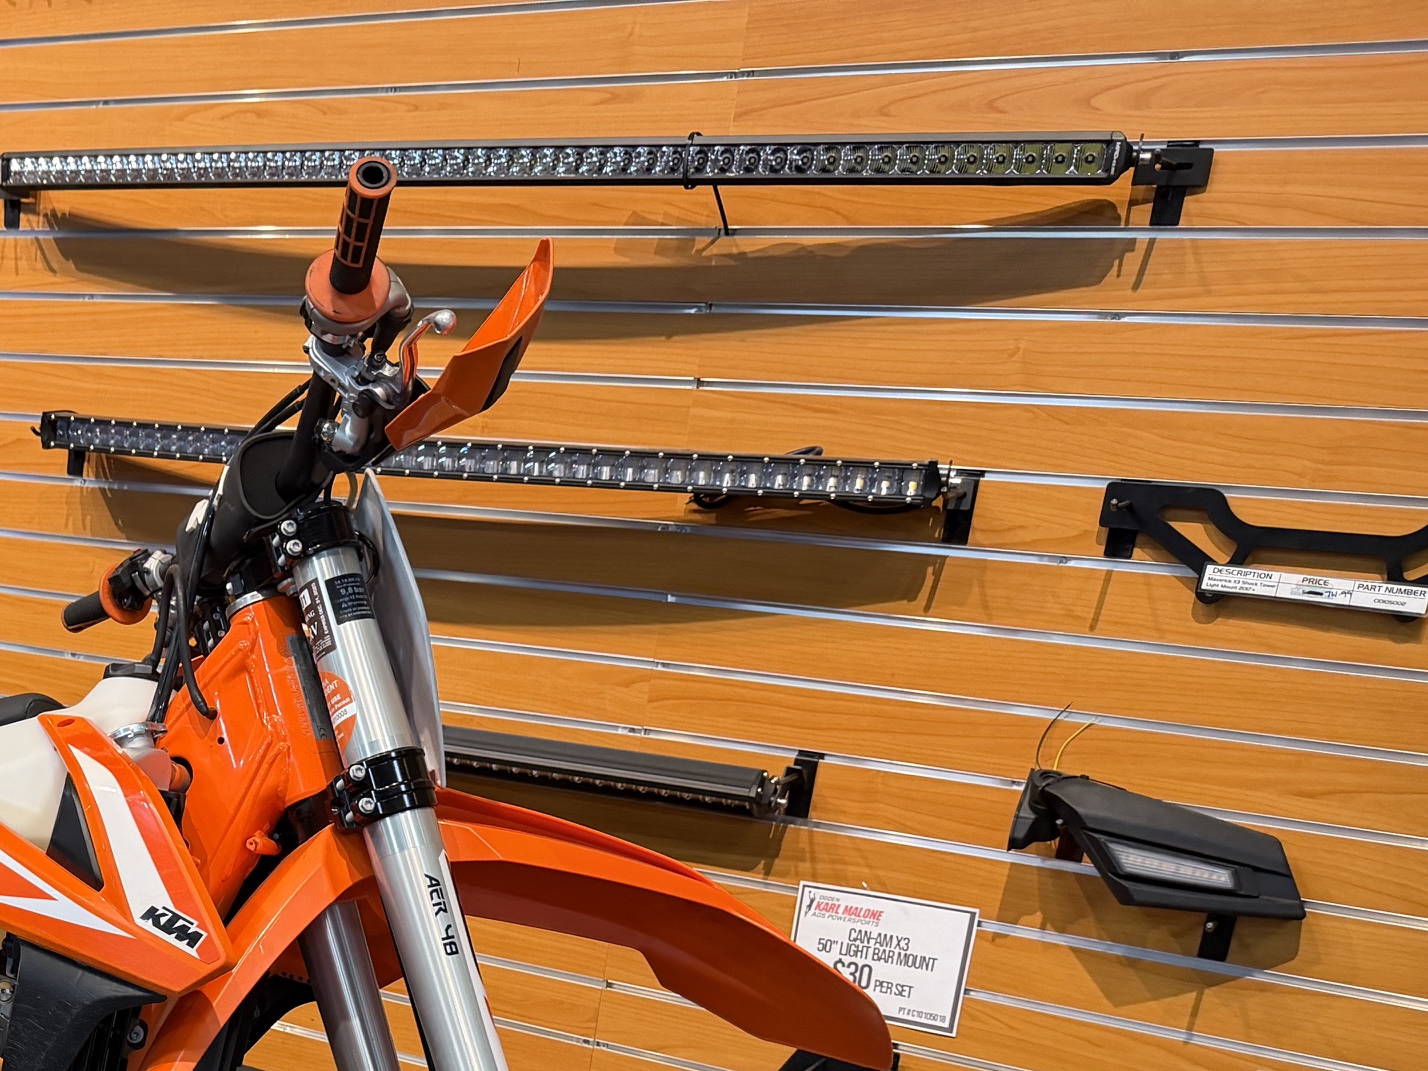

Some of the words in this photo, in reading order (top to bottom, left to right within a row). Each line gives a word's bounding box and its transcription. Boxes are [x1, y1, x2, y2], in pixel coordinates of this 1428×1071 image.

[1207, 576, 1232, 584] Maverick
[1242, 579, 1258, 587] Shock
[1212, 567, 1273, 580] DESCRIPTION
[1301, 576, 1330, 586] PRICE
[1220, 583, 1238, 591] Mount
[1357, 583, 1383, 593] PART
[1384, 584, 1427, 598] NUMBER
[424, 873, 448, 917] AER
[814, 901, 842, 915] KARL
[842, 905, 884, 922] MALONE
[139, 905, 203, 949] KTM
[827, 914, 880, 928] POWERSPORTS
[848, 928, 894, 949] CAN-AM
[894, 936, 911, 951] X3
[817, 938, 838, 953] 50"
[838, 941, 872, 960] LIGHT
[871, 947, 895, 965] BAR
[895, 951, 939, 972] MOUNT
[873, 979, 894, 995] PER
[894, 983, 914, 998] SET
